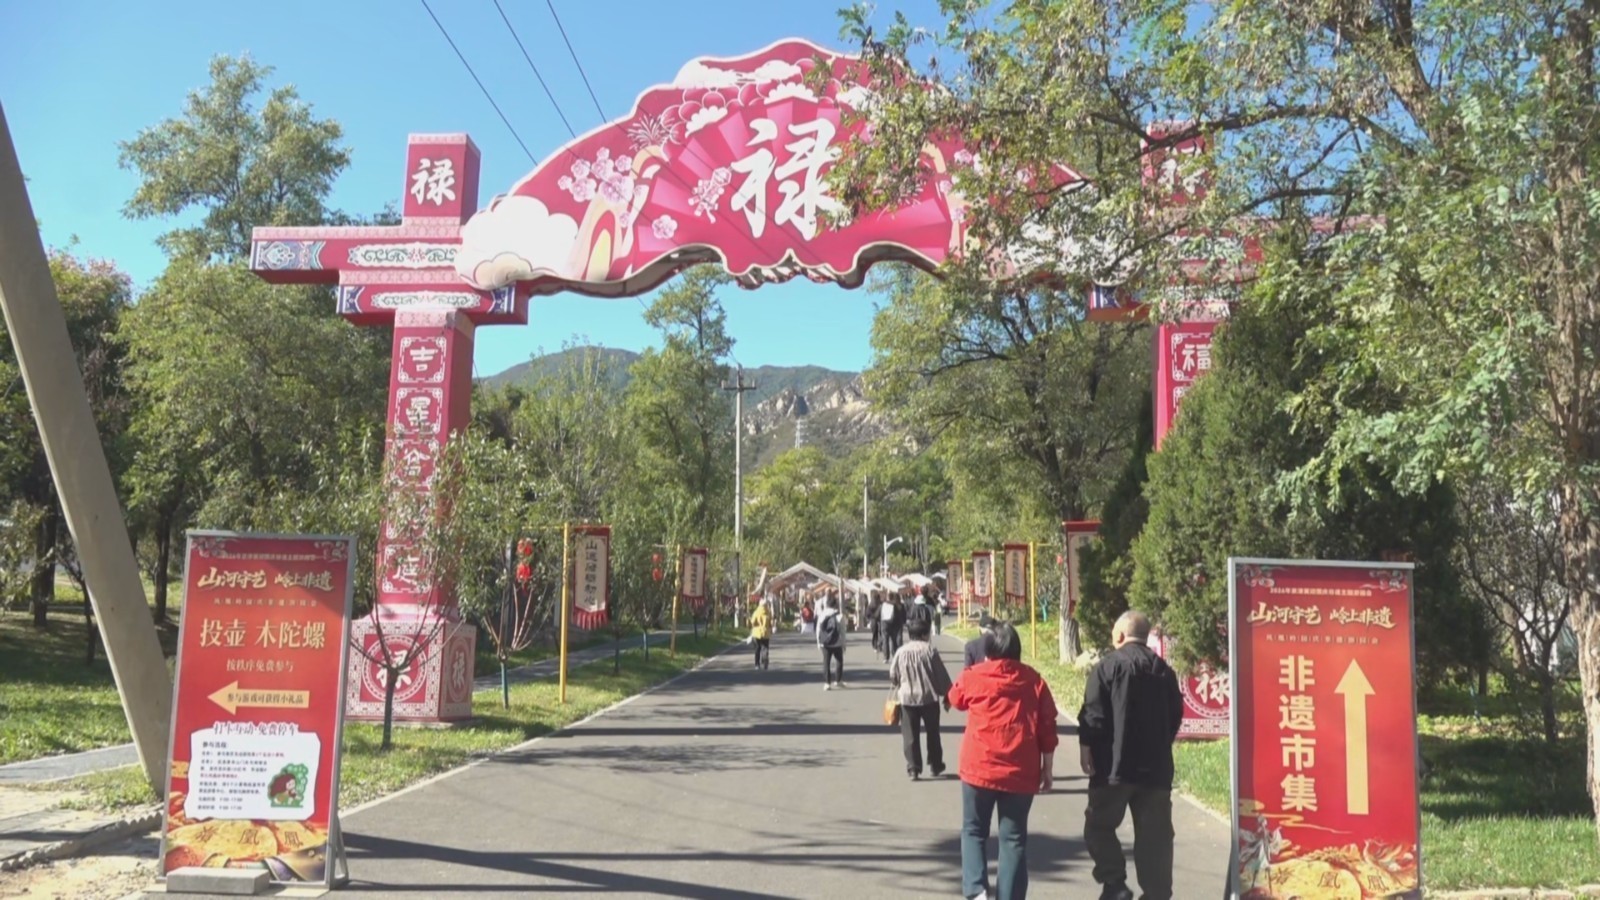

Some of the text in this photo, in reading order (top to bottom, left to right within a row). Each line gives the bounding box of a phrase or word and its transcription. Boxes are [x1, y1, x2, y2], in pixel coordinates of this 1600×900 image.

[410, 157, 456, 206] 禄
[731, 118, 852, 241] 禄
[1181, 343, 1213, 372] 福
[197, 566, 335, 592] 山河守艺 岭上非遗
[1247, 601, 1397, 629] 山河守艺 岭上非遗
[200, 618, 326, 649] 投壶 木陀螺
[226, 658, 294, 673] 按秩序免费参与
[227, 692, 304, 704] 参与游戏可获得小礼品
[1278, 654, 1318, 812] 非遗市集
